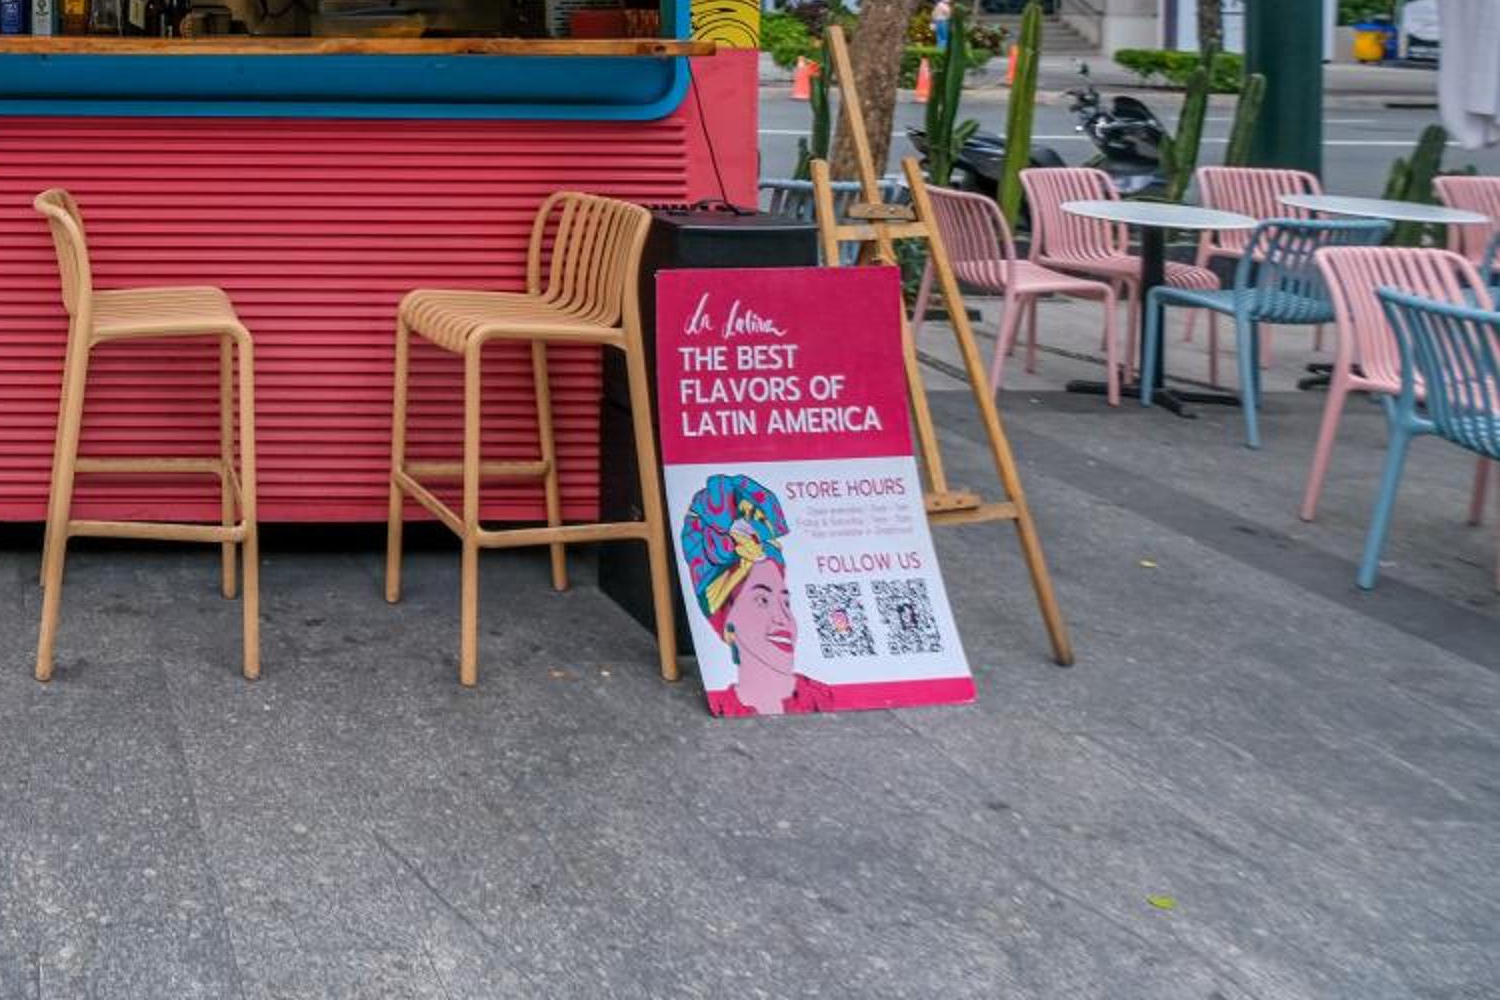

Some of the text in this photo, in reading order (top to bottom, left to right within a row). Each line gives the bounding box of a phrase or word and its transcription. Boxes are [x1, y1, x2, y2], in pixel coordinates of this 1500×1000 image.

[678, 344, 799, 372] THE BEST
[680, 375, 845, 404] FLAVORS OF
[681, 406, 884, 438] LATIN AMERICA
[785, 477, 906, 500] STORE HOURS
[816, 551, 922, 574] FOLLOW US
